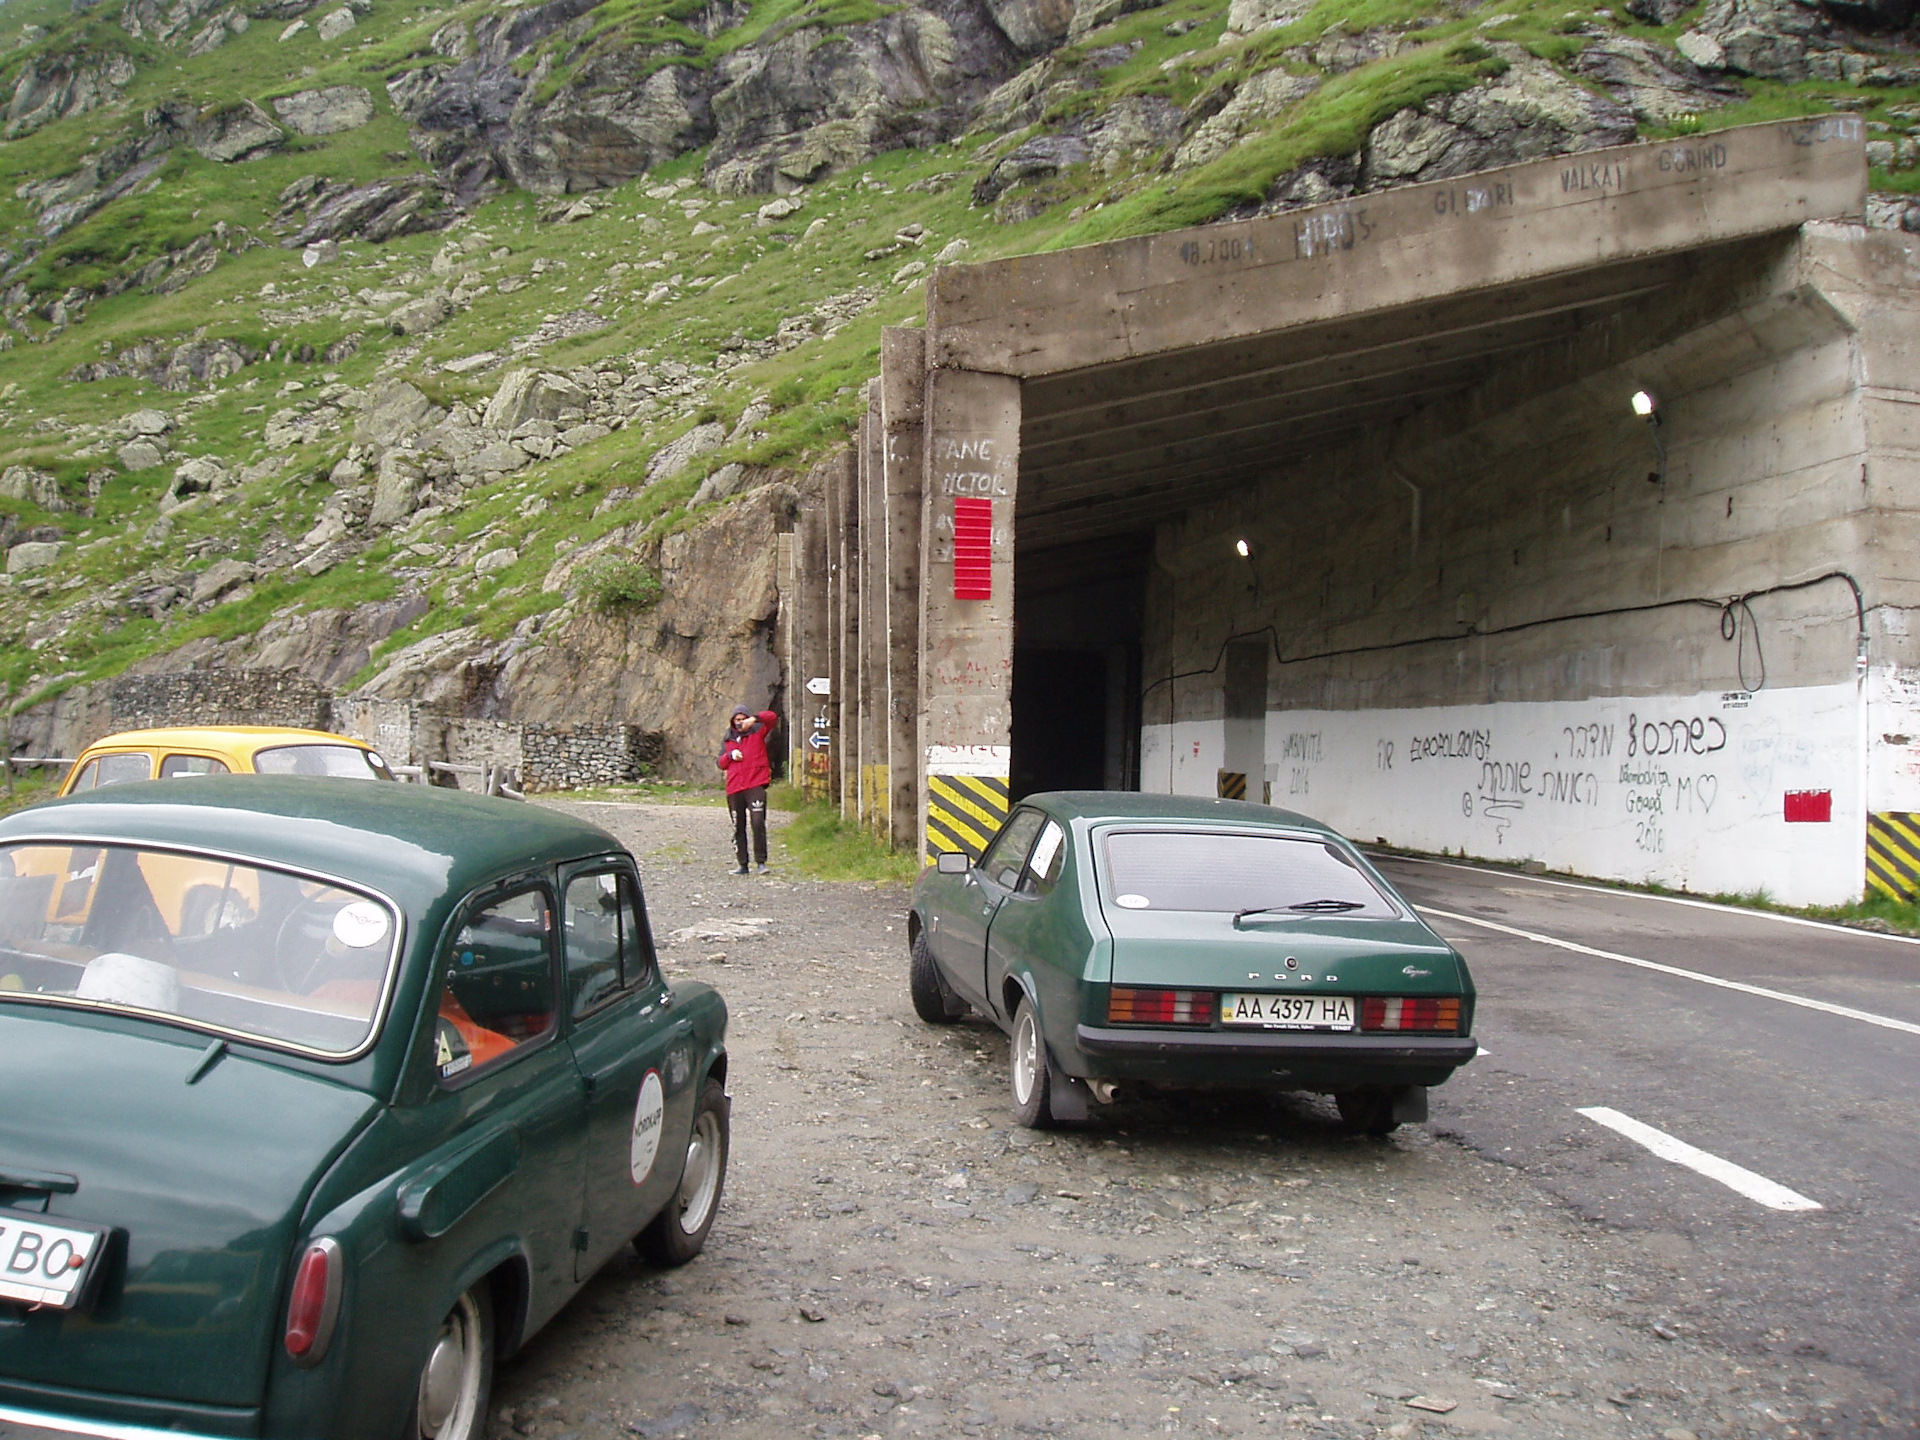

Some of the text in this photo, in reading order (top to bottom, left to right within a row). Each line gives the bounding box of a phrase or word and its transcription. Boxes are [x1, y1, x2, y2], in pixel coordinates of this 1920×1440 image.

[1248, 972, 1339, 982] FORD
[1235, 997, 1350, 1021] AA 4397 HA
